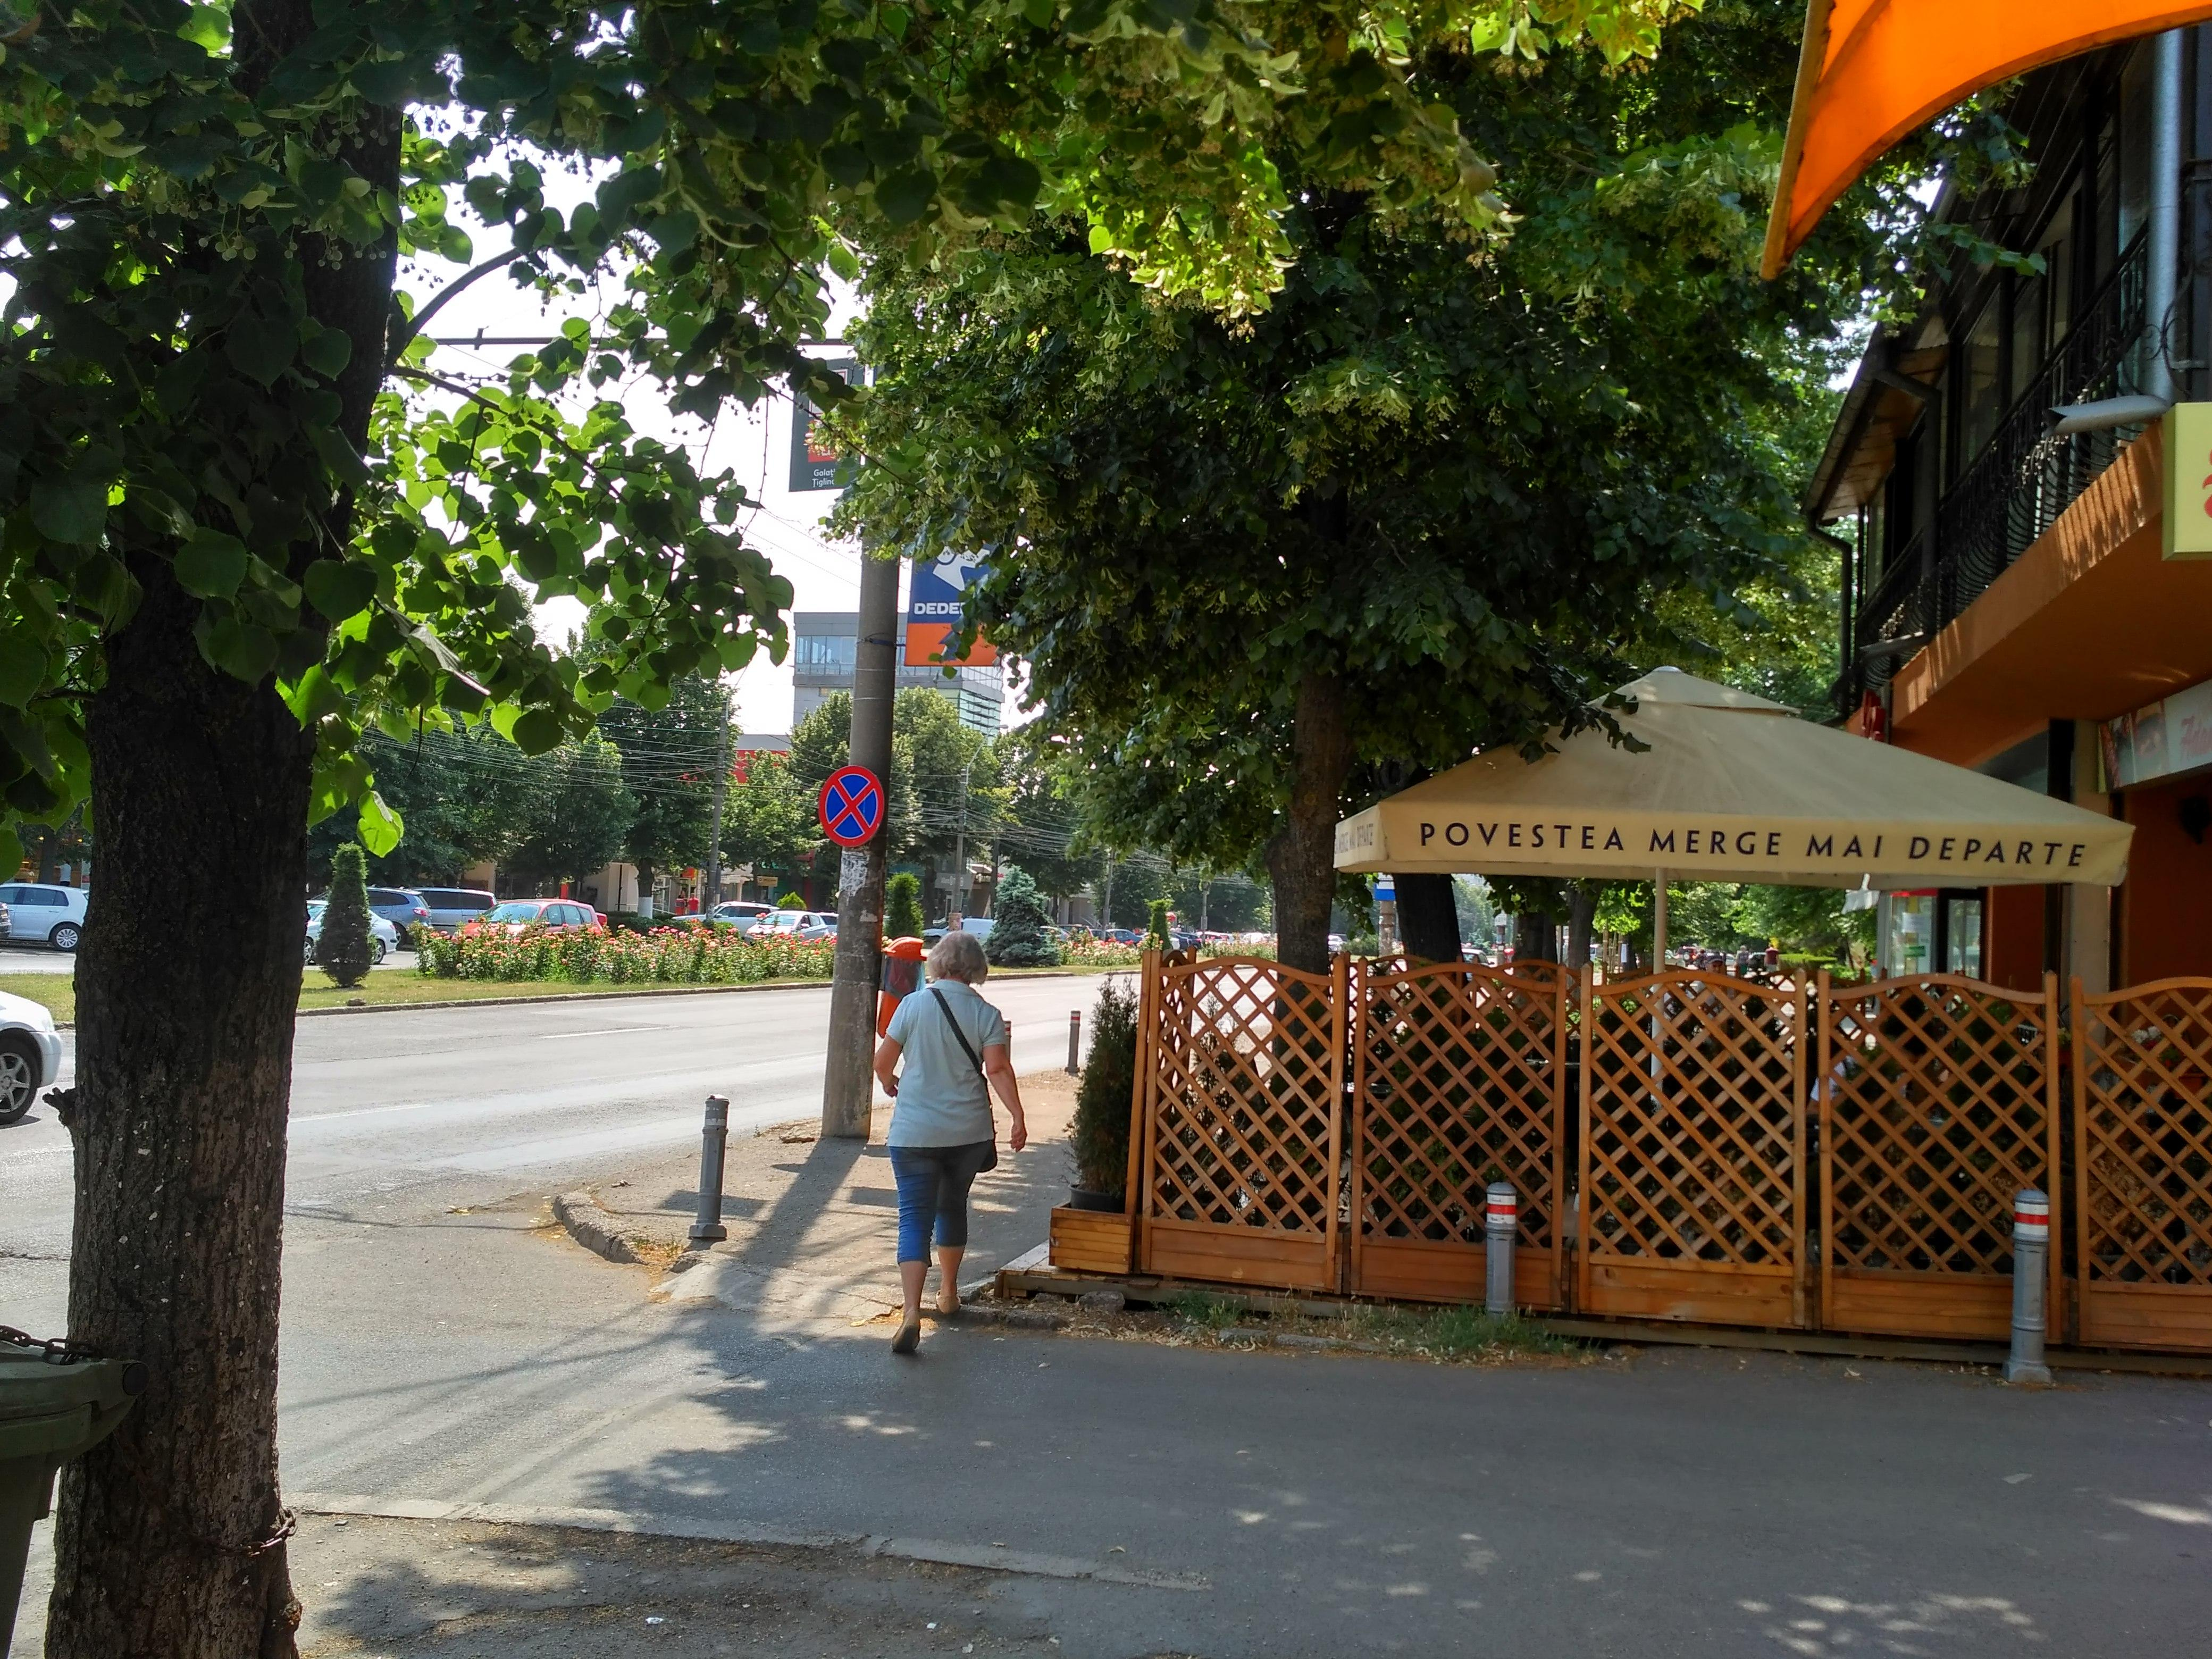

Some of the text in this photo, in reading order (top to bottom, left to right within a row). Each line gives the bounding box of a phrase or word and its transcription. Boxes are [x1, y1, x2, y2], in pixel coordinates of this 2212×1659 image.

[1420, 822, 2085, 866] POVESTEA MERGE MAI DEPARTE
